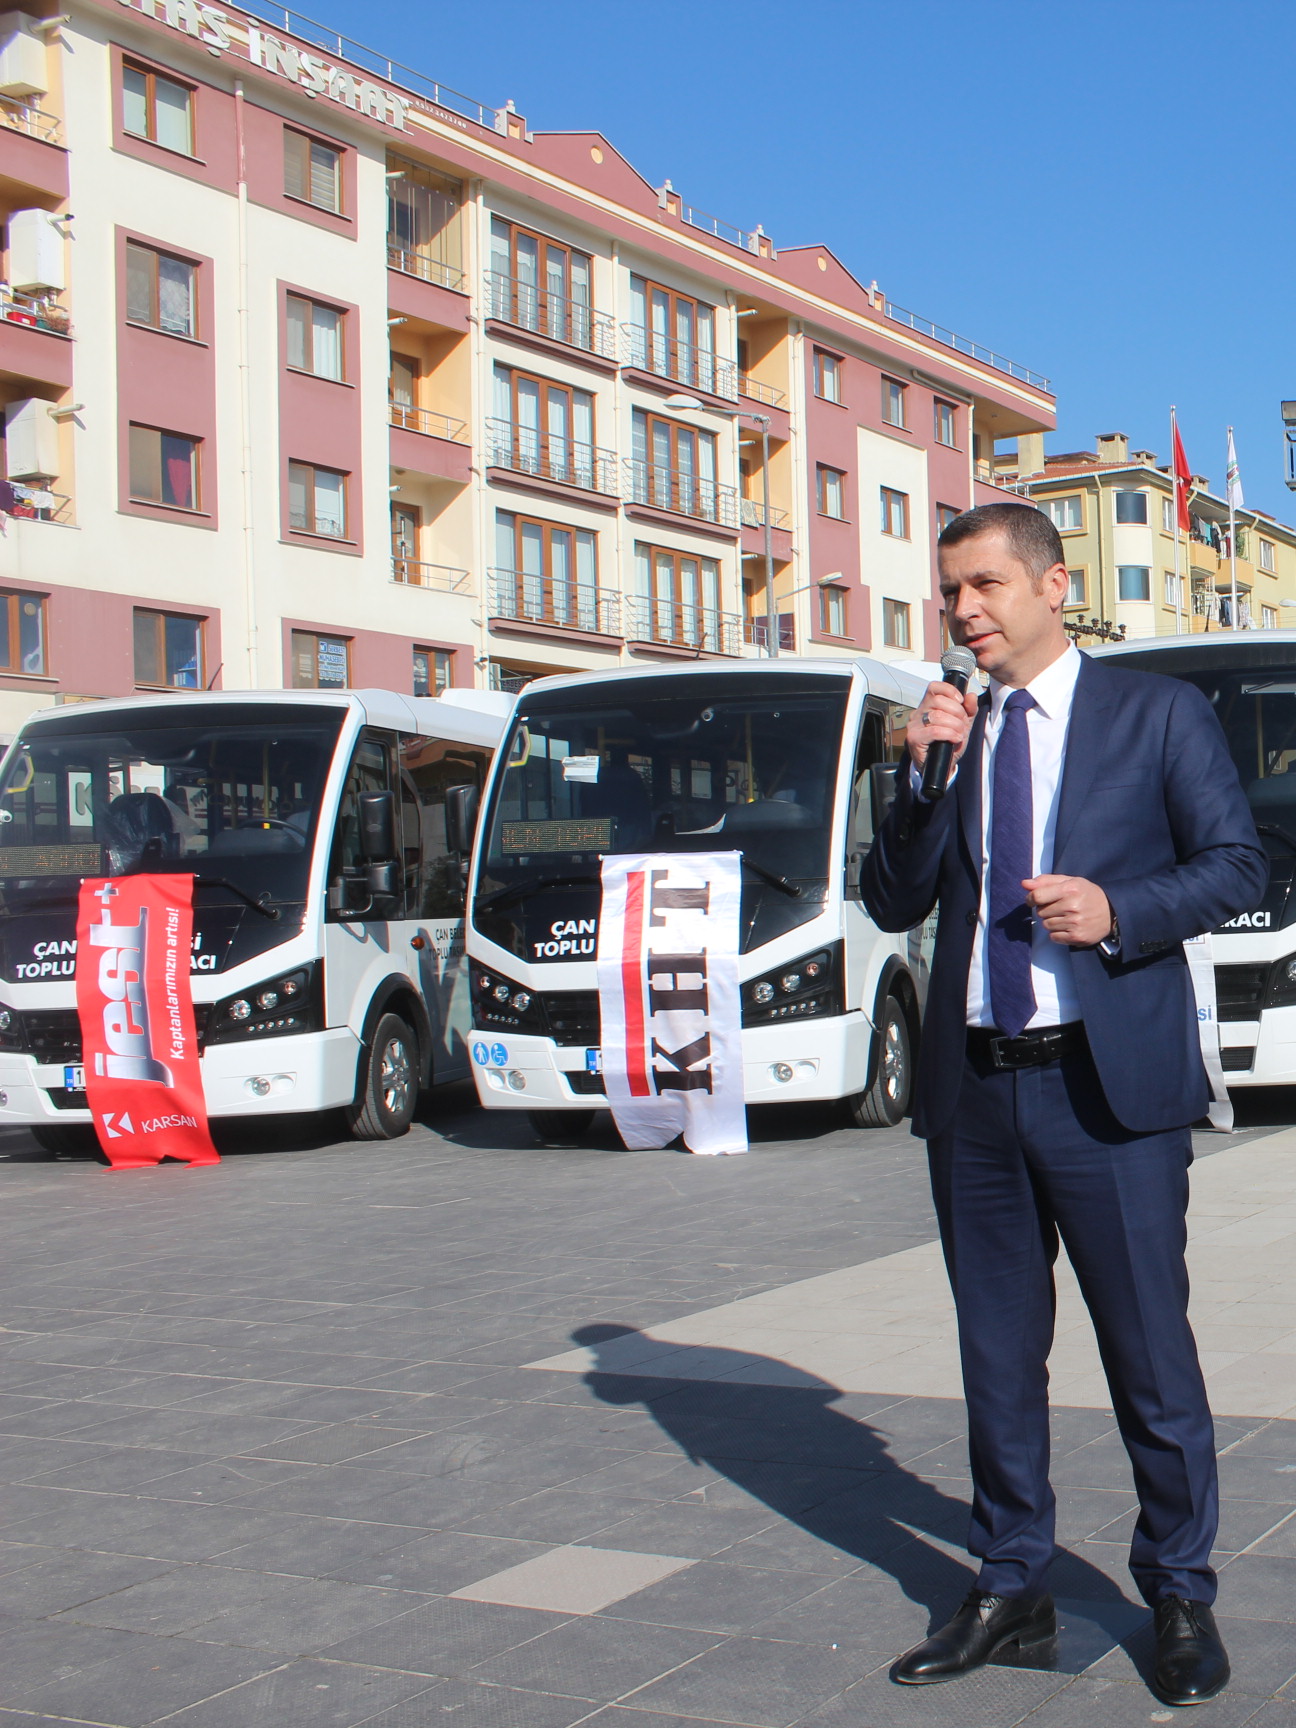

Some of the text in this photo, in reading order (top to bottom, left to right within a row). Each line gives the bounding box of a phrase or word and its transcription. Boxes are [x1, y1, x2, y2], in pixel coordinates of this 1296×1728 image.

[551, 919, 596, 940] ÇAN
[33, 940, 77, 960] ÇAN
[534, 939, 595, 957] TOPLU
[16, 961, 76, 978] TOPLU
[141, 1114, 198, 1134] KARSAN
